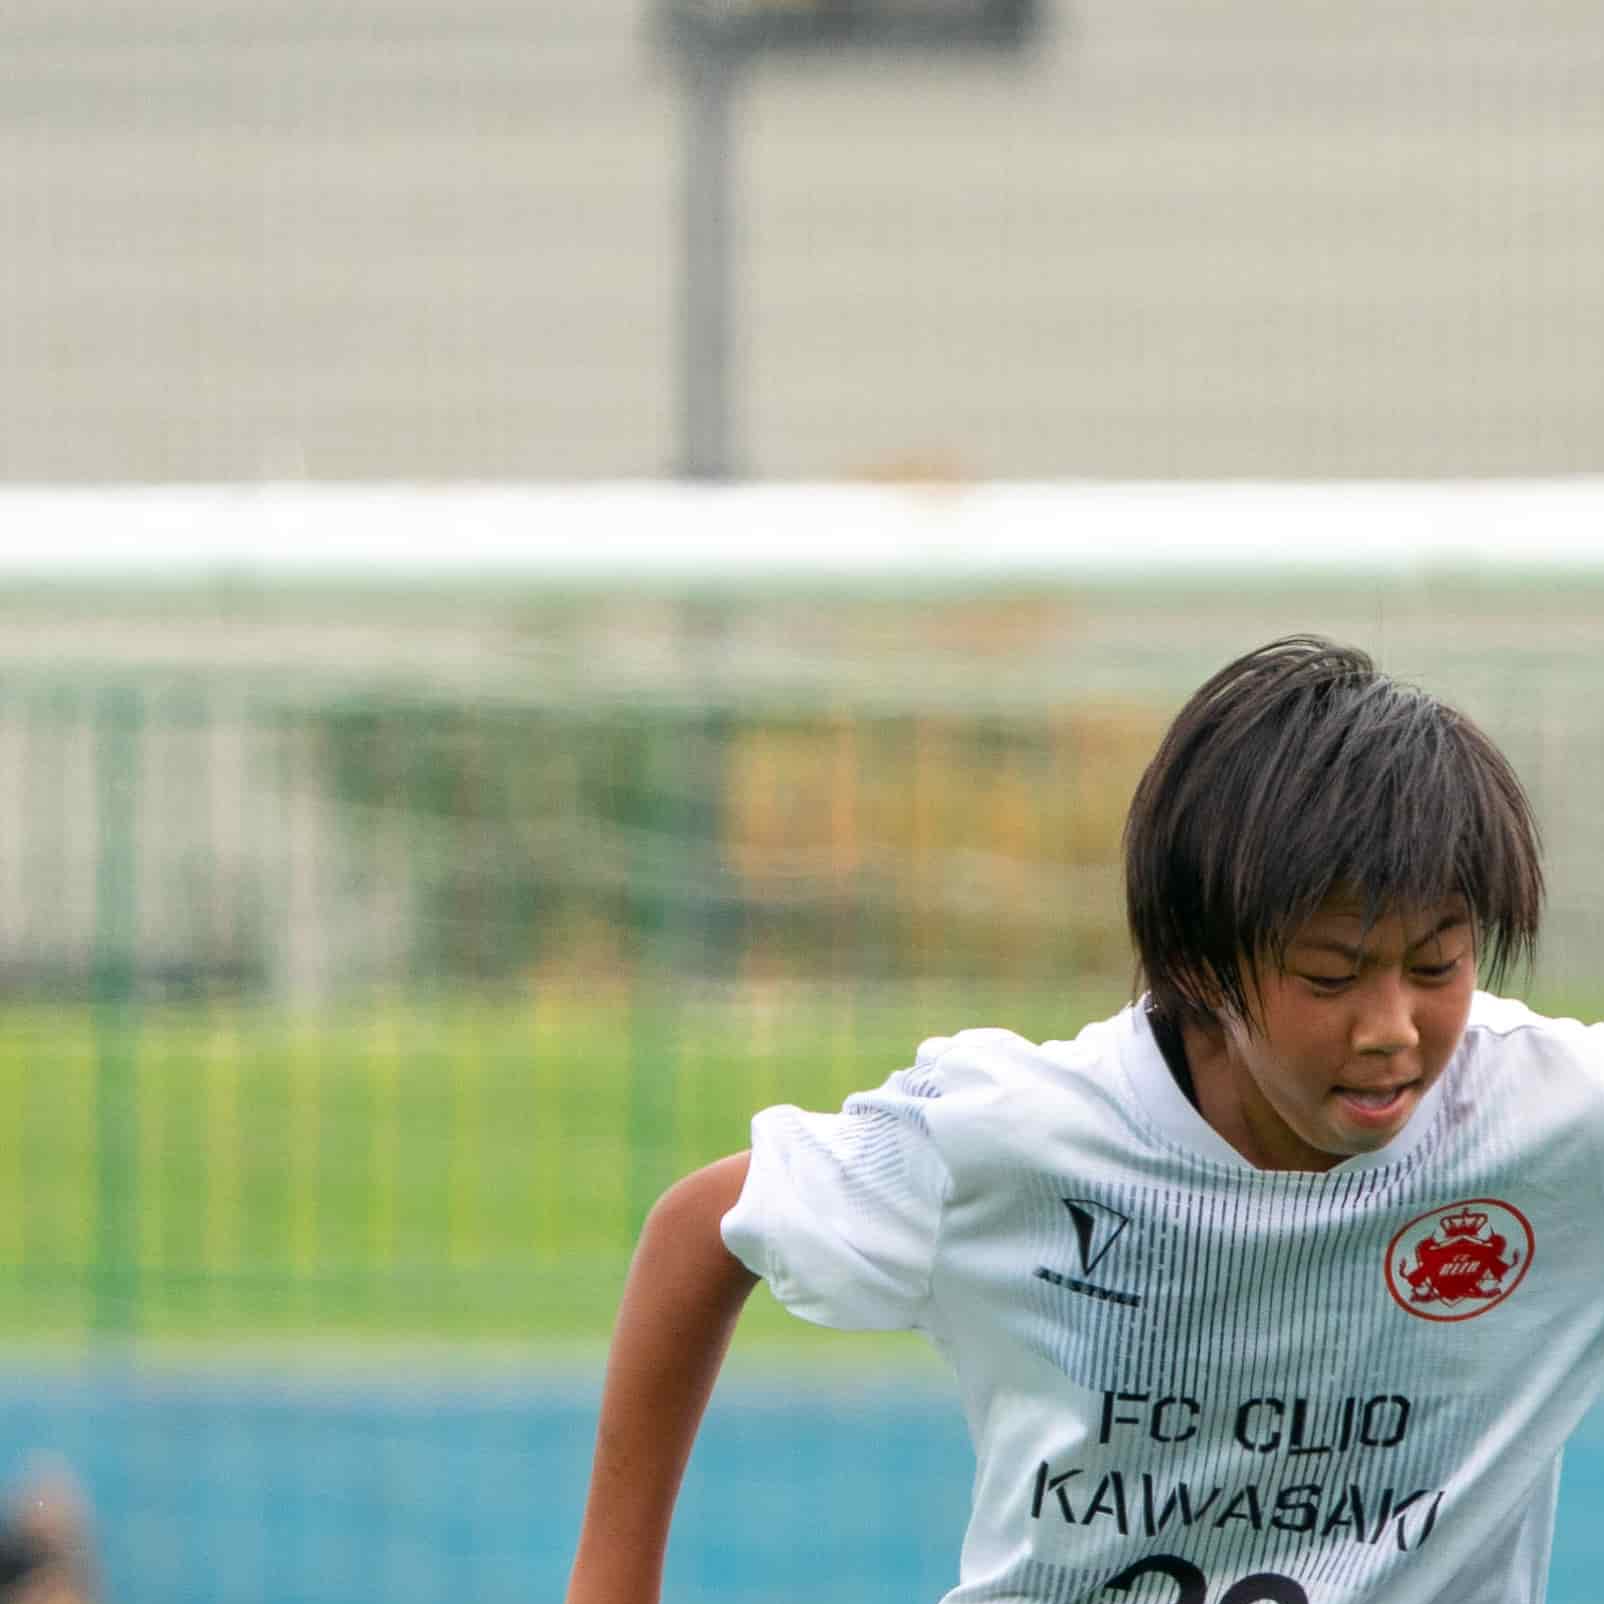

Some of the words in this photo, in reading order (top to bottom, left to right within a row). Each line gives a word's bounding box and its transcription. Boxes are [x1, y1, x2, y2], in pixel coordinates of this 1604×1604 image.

[1099, 1391, 1200, 1444] FC
[1234, 1395, 1412, 1455] CLIO
[1031, 1461, 1446, 1552] KAWASAKI
